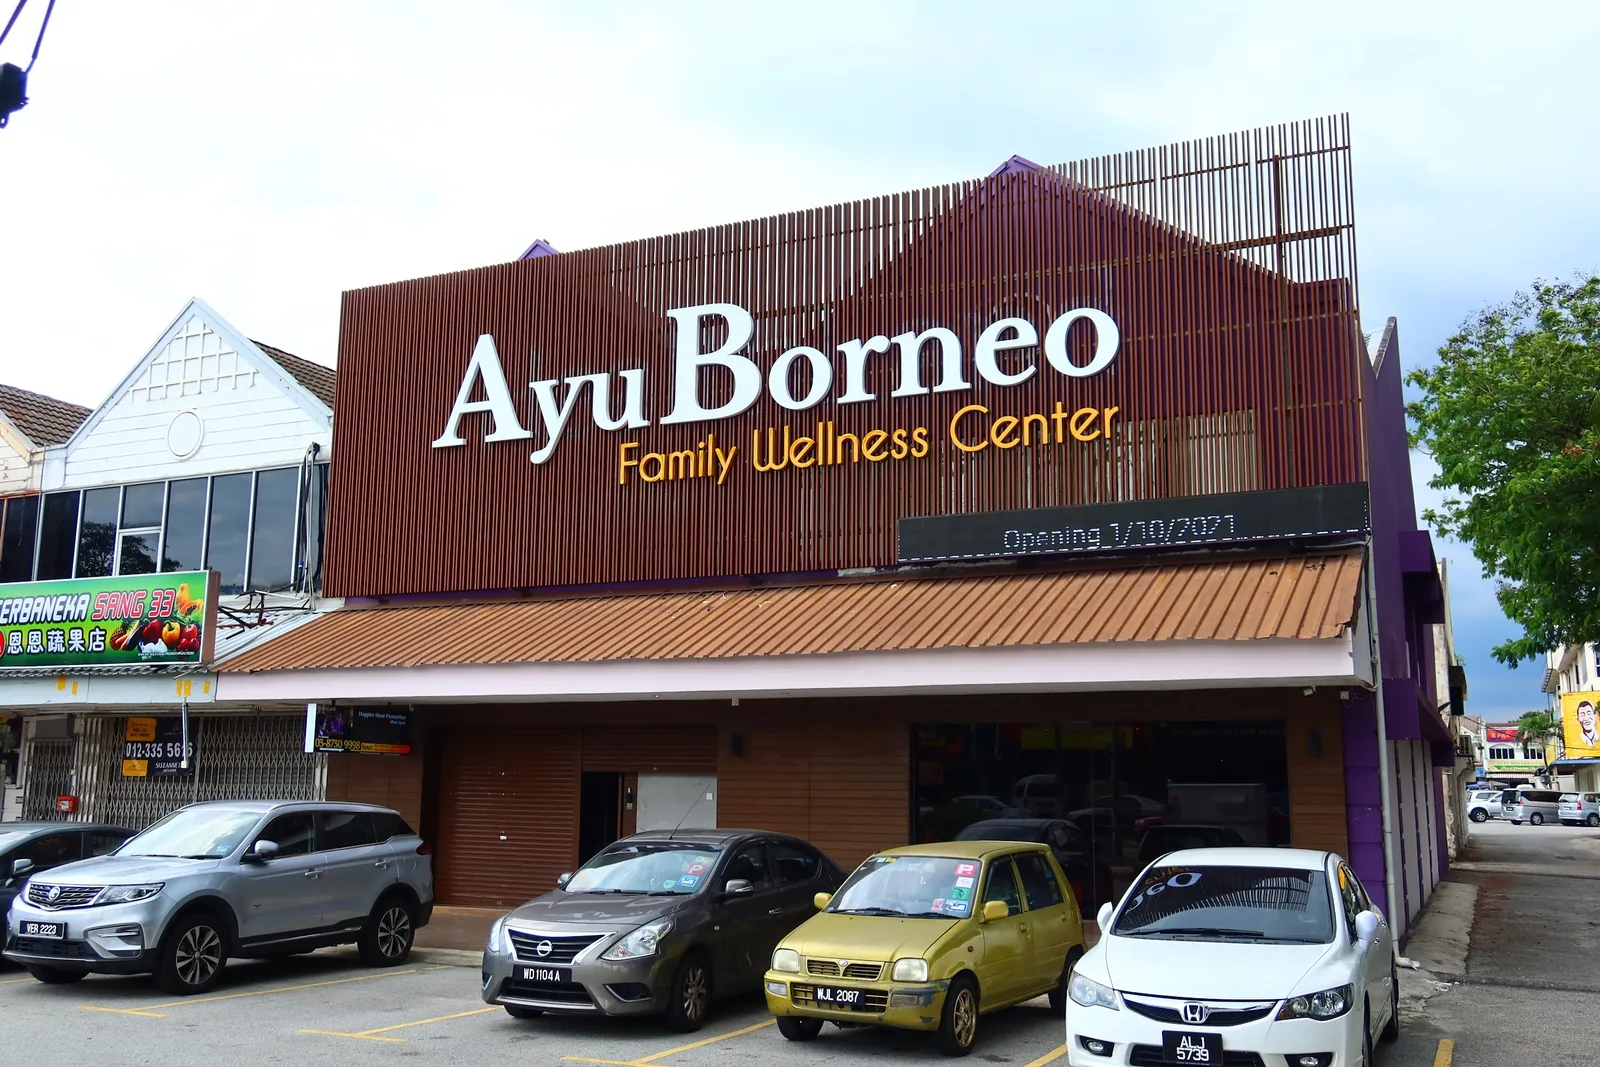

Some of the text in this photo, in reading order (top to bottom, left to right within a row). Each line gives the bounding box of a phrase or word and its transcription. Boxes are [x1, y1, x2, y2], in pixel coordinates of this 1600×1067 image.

[431, 302, 1120, 465] Ayu Borneo
[619, 401, 1119, 485] Family Wellness Center
[1003, 514, 1234, 553] Opening 1/10/2021
[0, 589, 176, 625] ERBANEKA SANG 33
[7, 627, 106, 655] 恩恩蔬果店
[26, 923, 57, 935] VER 2223
[523, 967, 561, 982] WD 1104 A
[817, 987, 859, 1003] WJL 2087
[1180, 1035, 1205, 1049] ALJ
[1176, 1046, 1210, 1062] 5739
